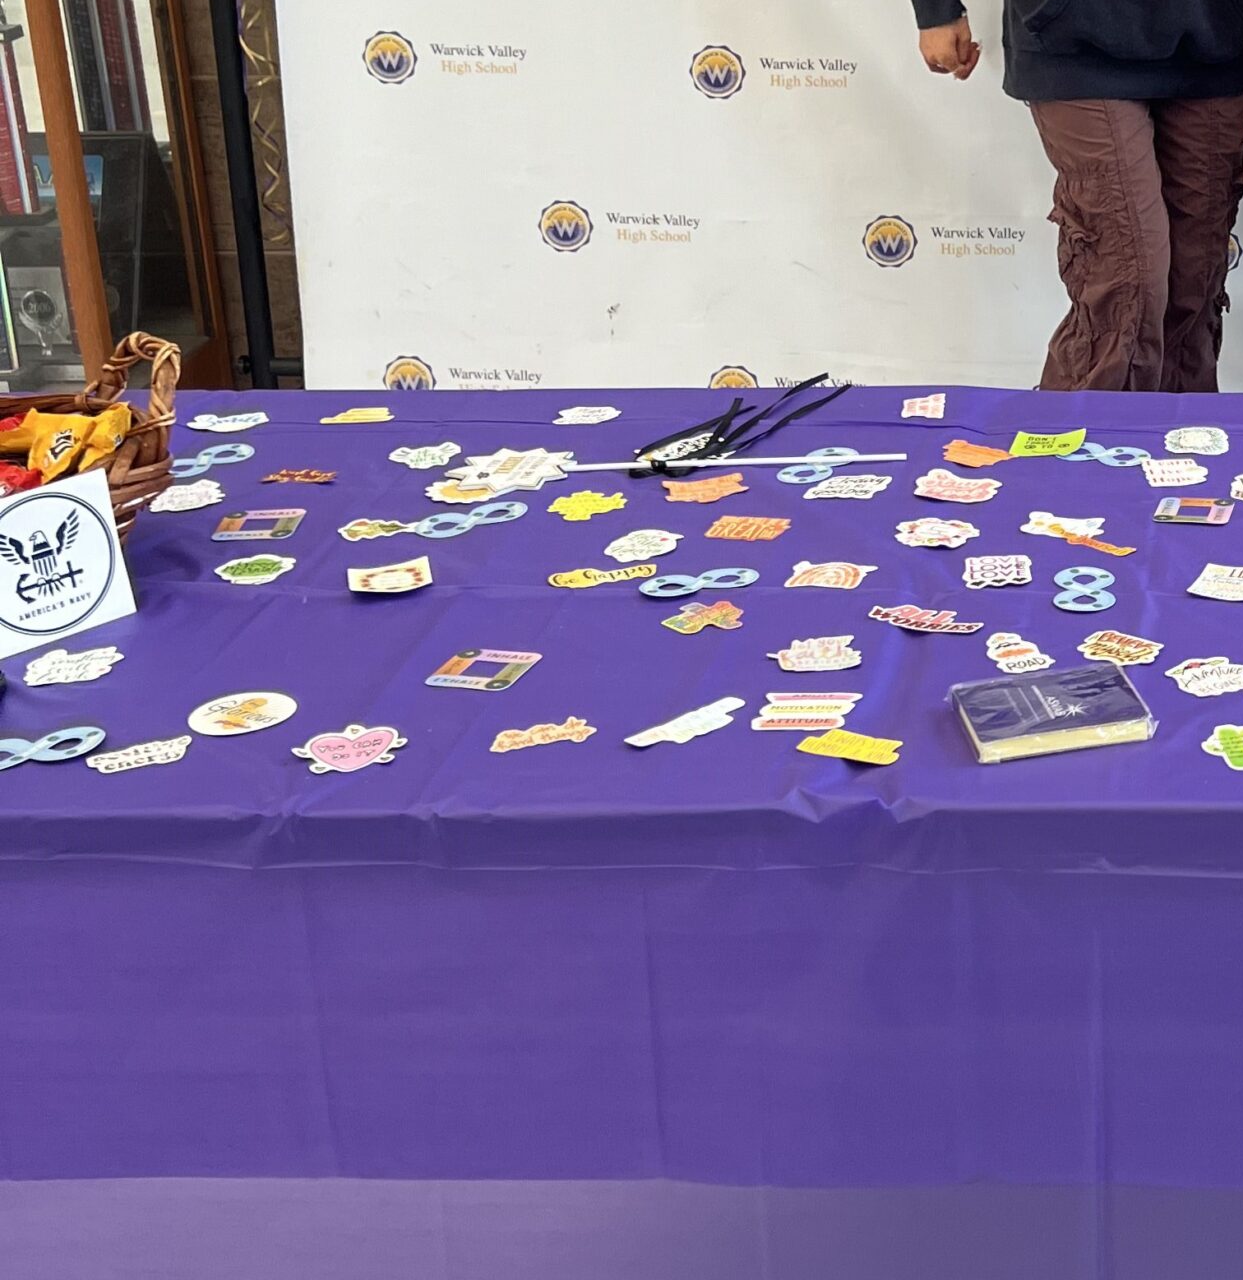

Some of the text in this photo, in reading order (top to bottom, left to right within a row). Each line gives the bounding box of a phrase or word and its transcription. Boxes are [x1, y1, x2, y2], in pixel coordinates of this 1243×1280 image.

[760, 58, 857, 74] Warwick Valley
[771, 75, 847, 88] High School
[606, 212, 700, 229] Warwick Valley
[617, 229, 691, 243] High School
[931, 227, 1025, 241] Warwick Valley
[941, 244, 1015, 257] High School
[709, 521, 766, 539] GREAT
[19, 592, 92, 622] AMERICA'S NAVY
[872, 609, 983, 632] WORRIES
[1005, 656, 1048, 671] ROAD
[766, 717, 832, 725] ATTITUDE
